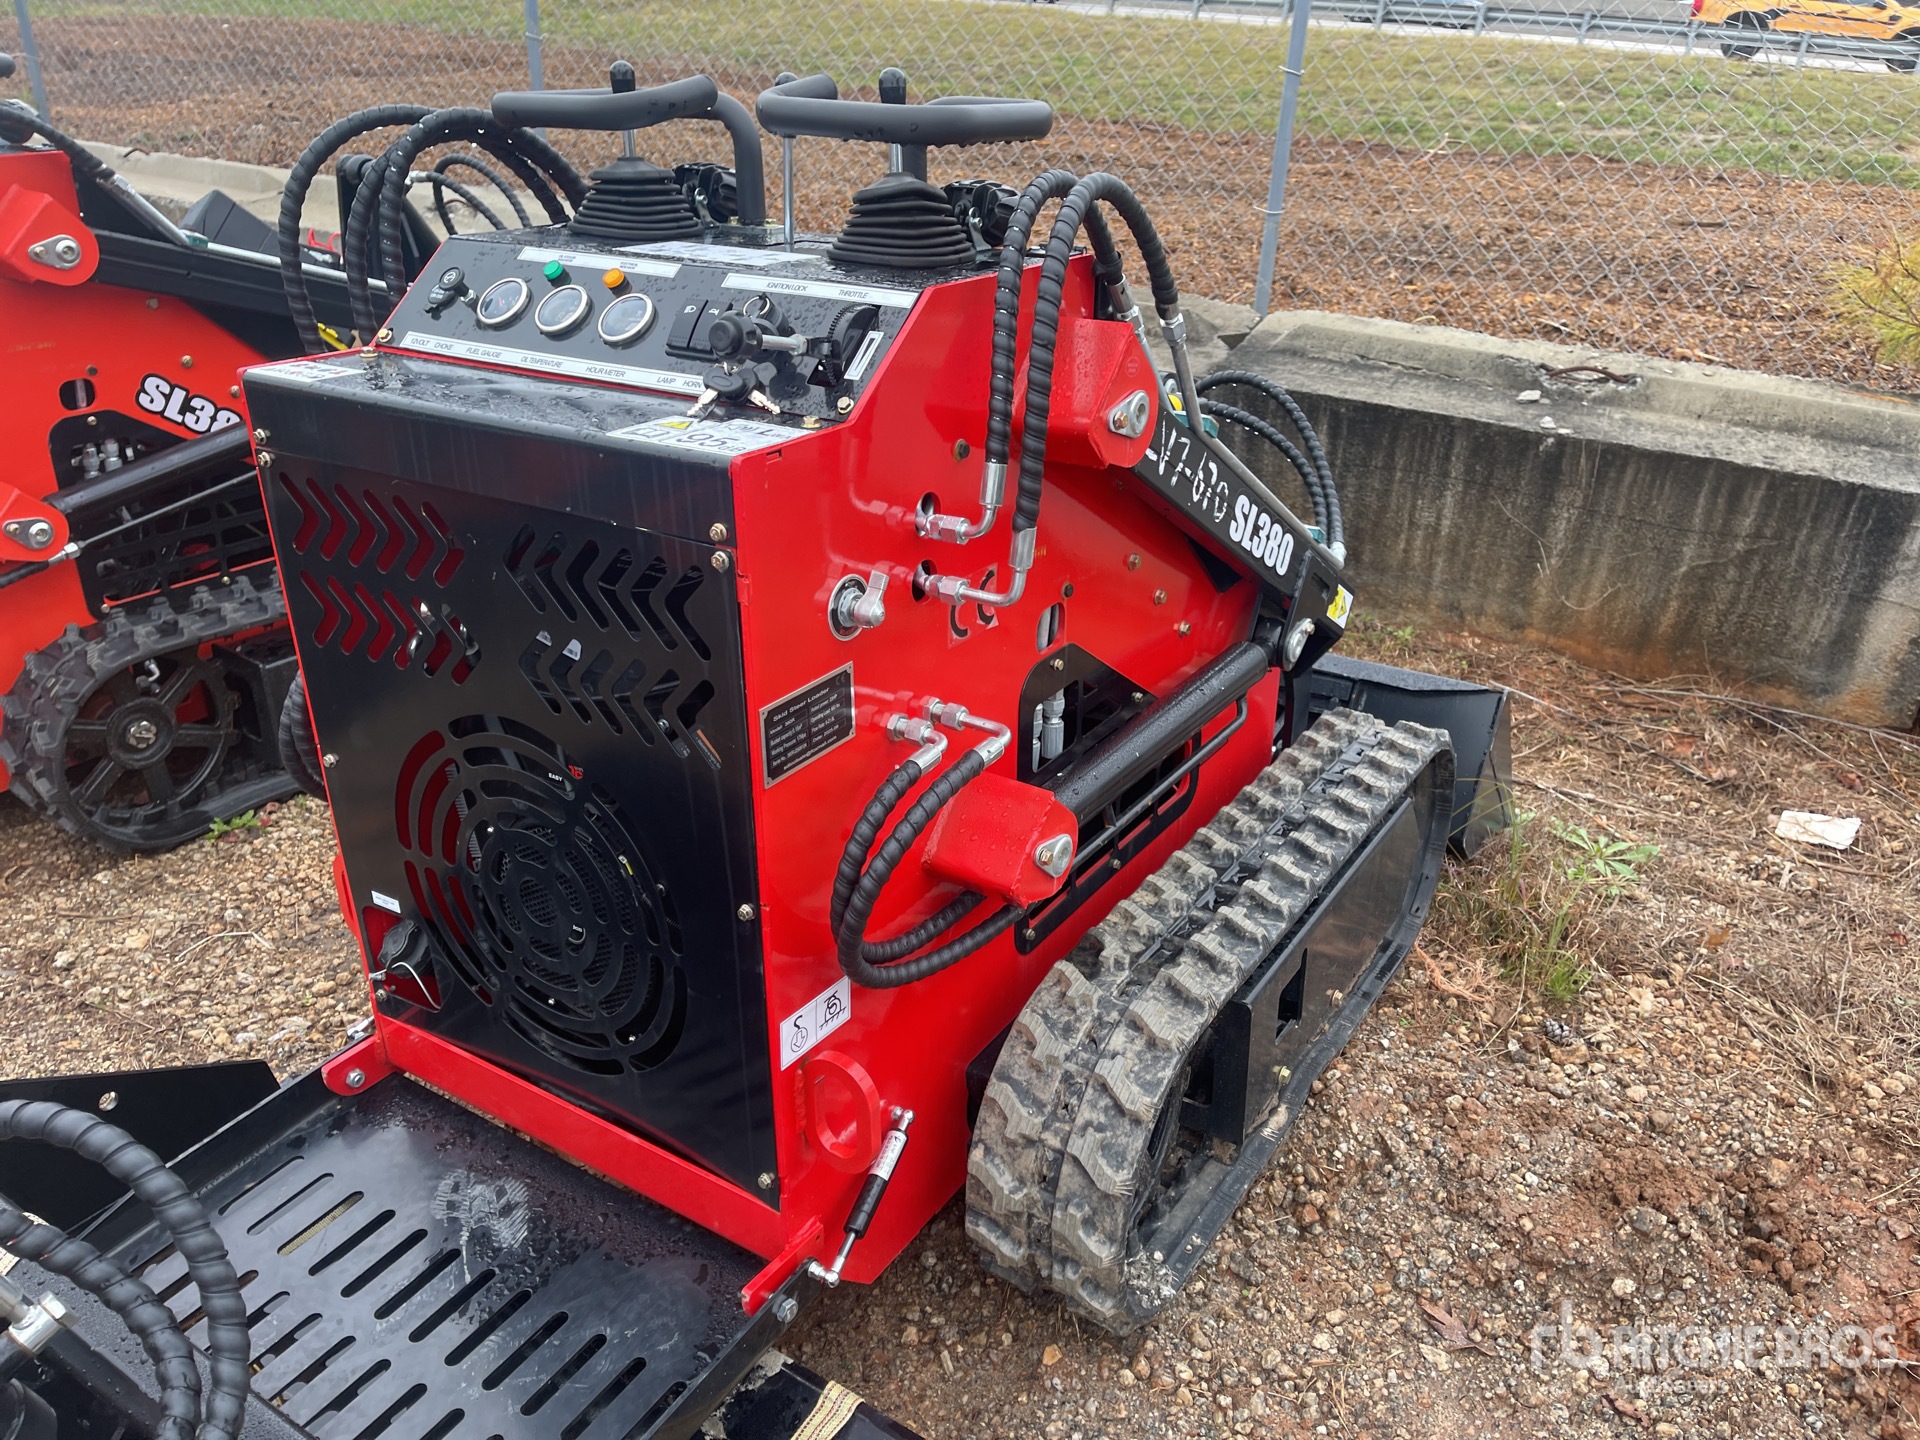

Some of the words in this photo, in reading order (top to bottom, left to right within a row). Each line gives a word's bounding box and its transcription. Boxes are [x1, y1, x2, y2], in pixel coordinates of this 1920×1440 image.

[766, 281, 791, 291] IGNITION
[790, 284, 808, 292] LOCK
[838, 289, 869, 299] THROTTLE
[434, 342, 454, 351] CHOKE
[466, 347, 480, 356] FUEL
[481, 349, 502, 359] GAUGE
[529, 356, 564, 369] TEMPERATURE
[585, 366, 605, 375] HOUR
[604, 368, 626, 378] METER
[656, 376, 677, 385] LAMP
[683, 379, 702, 389] HORN
[1229, 494, 1294, 576] SL380
[773, 710, 788, 721] Skid
[789, 700, 806, 713] Steer
[807, 687, 830, 703] Loader
[548, 772, 563, 782] EASY
